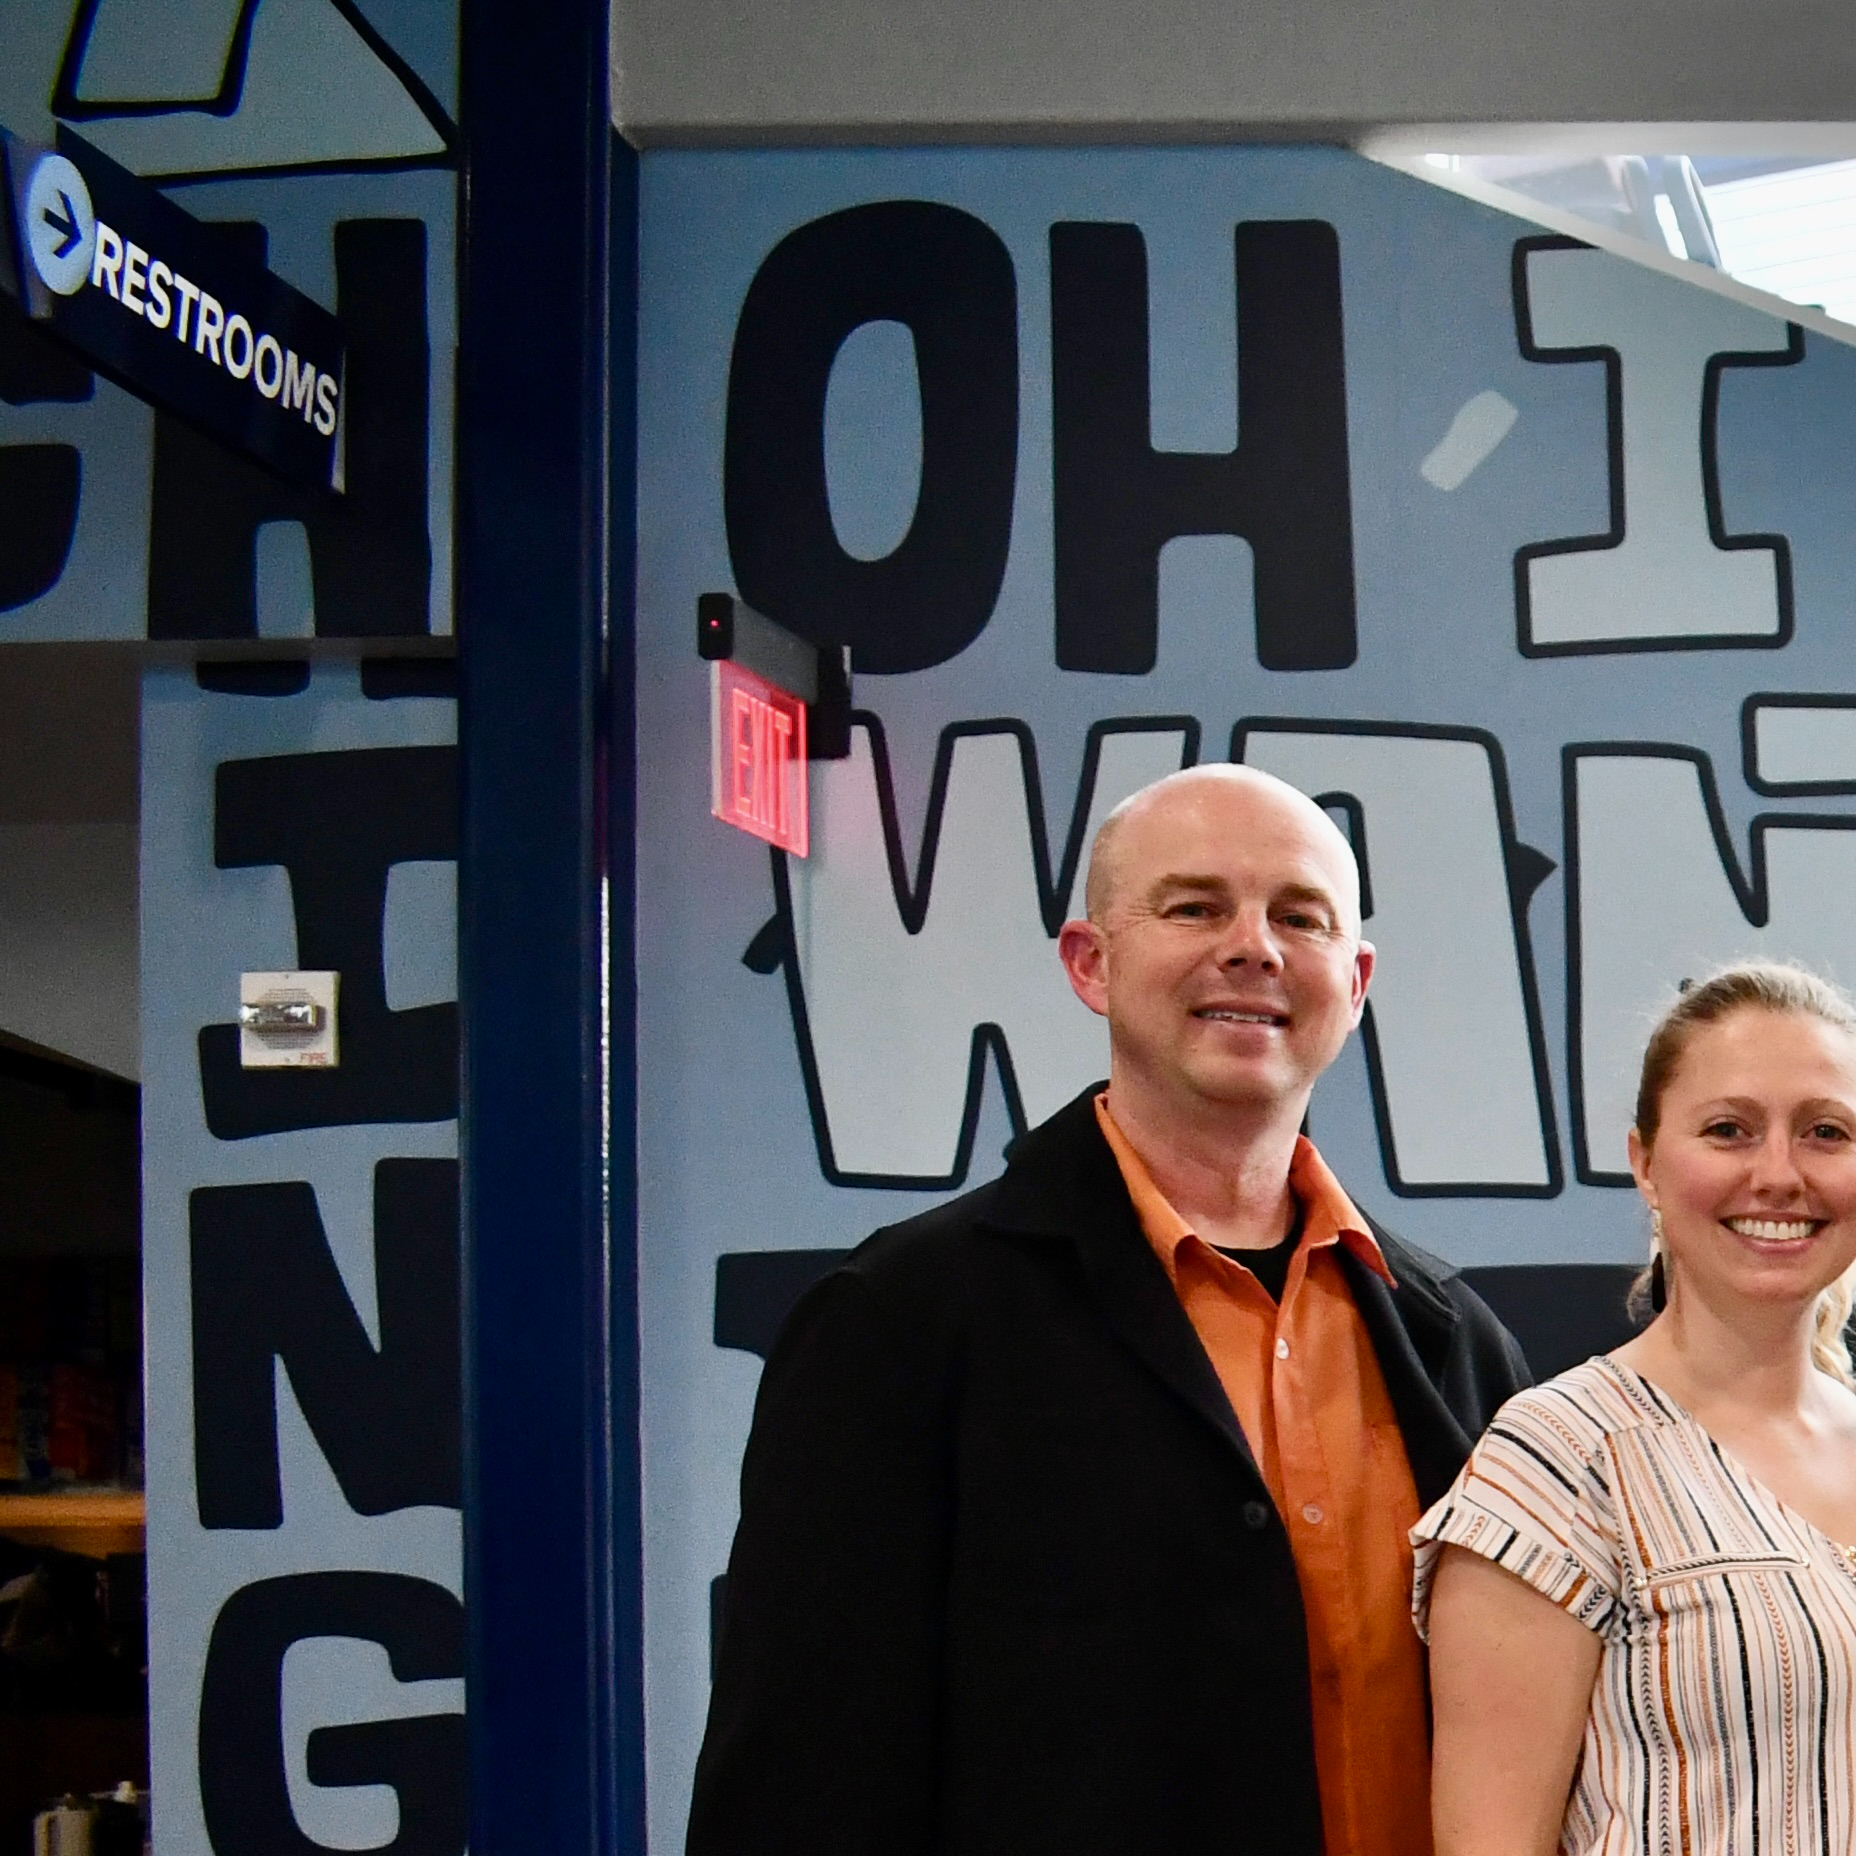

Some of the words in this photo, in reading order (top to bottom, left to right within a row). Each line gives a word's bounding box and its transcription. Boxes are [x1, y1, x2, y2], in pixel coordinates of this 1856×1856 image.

[92, 220, 339, 436] RESTROOMS
[723, 198, 1360, 676] OH
[1511, 235, 1806, 659] I
[732, 687, 792, 835] EXIT
